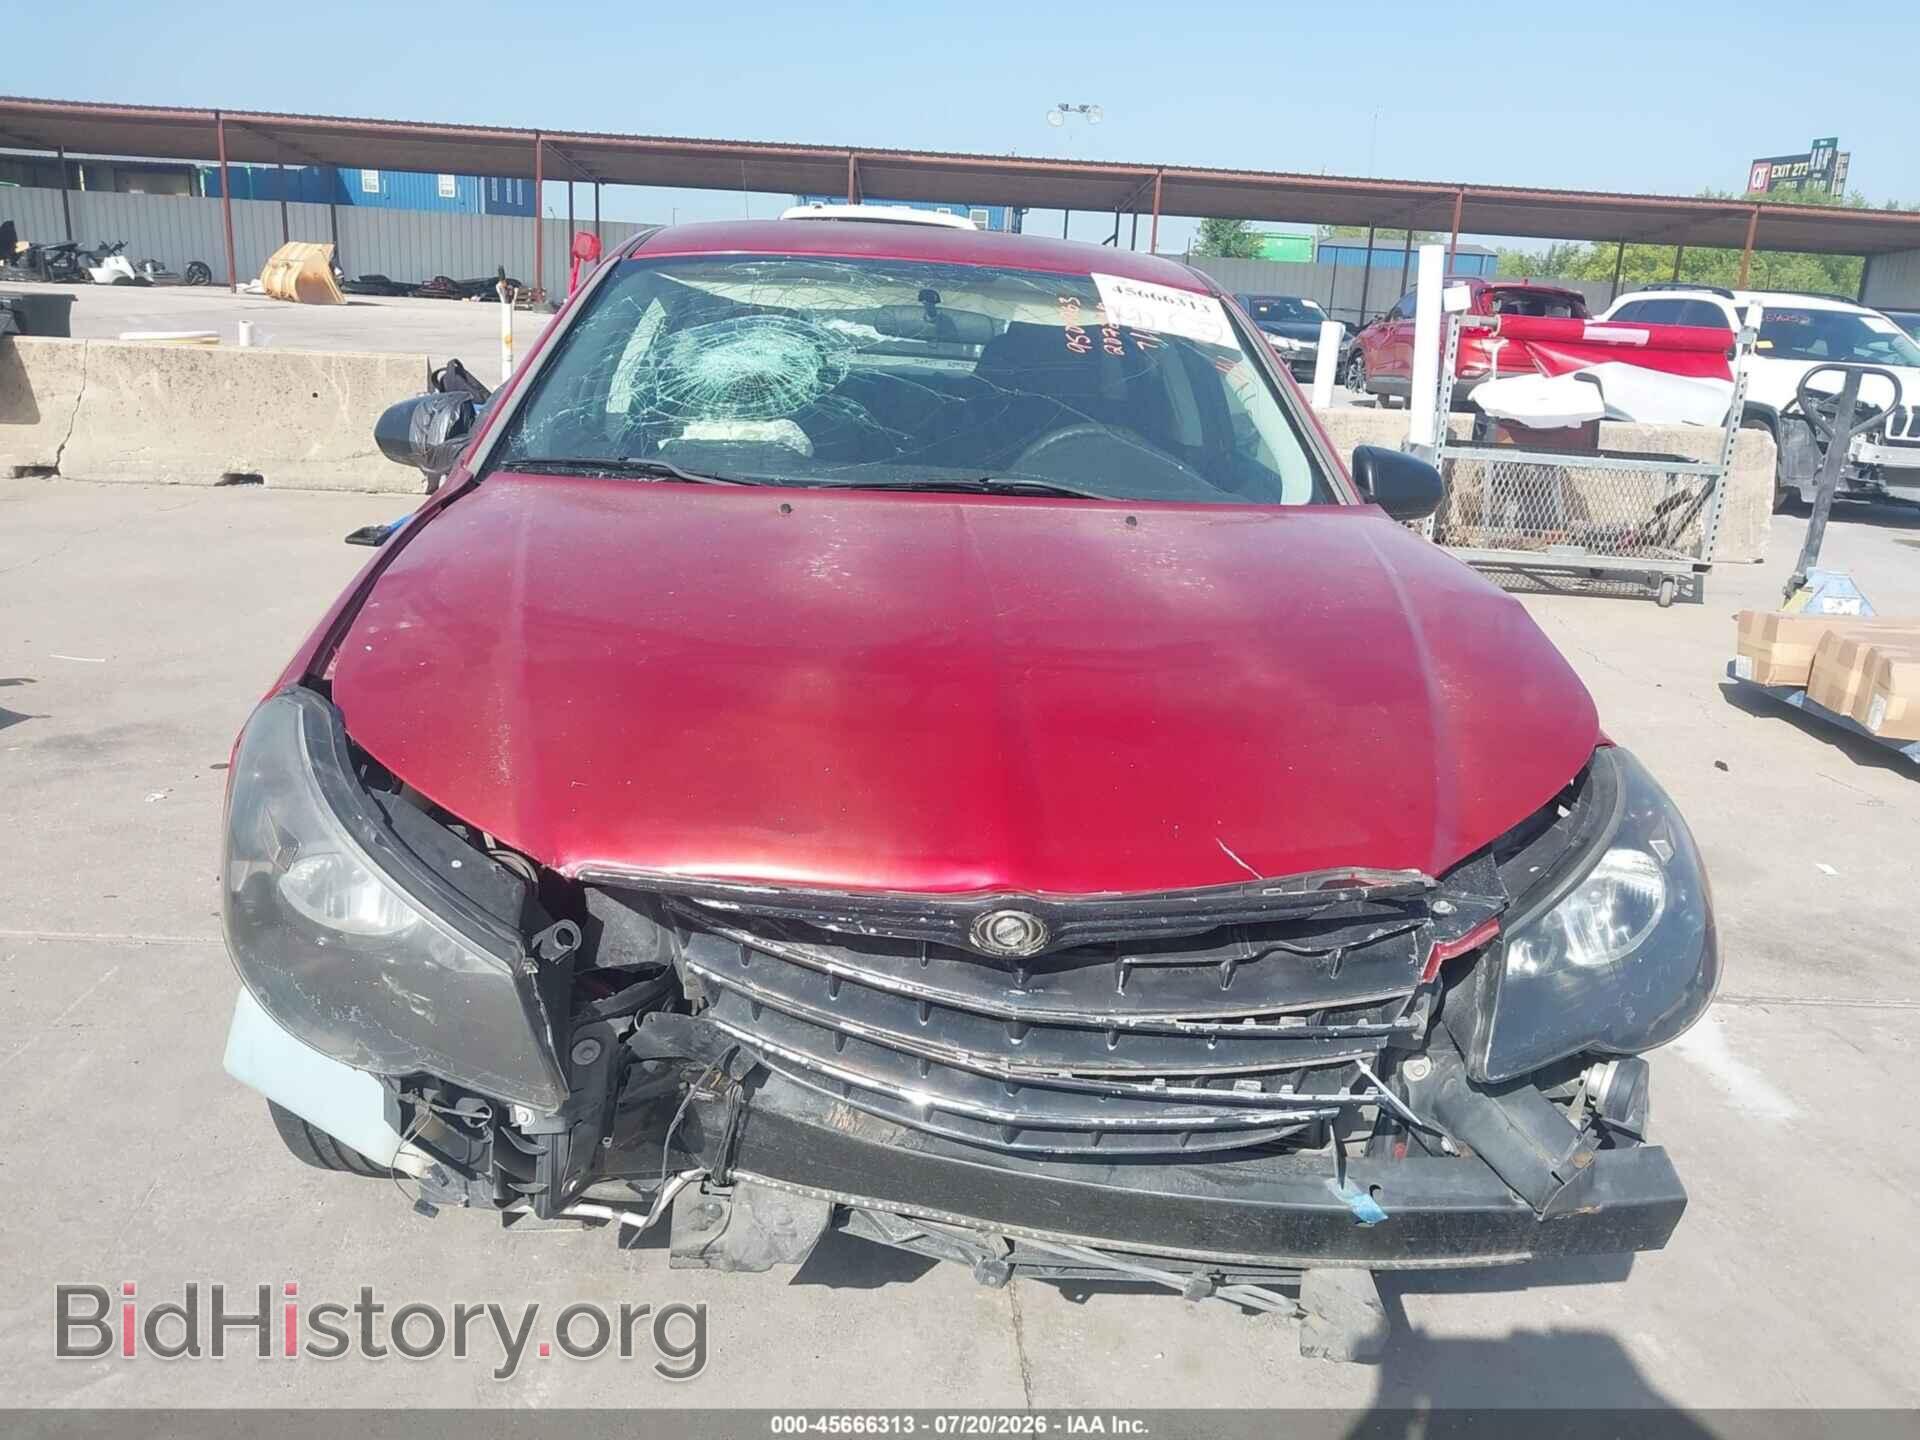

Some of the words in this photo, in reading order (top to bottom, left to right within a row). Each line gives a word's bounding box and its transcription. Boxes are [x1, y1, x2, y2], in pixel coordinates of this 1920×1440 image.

[1752, 167, 1768, 189] QT
[1771, 164, 1790, 179] EXIT
[1792, 162, 1809, 177] 273
